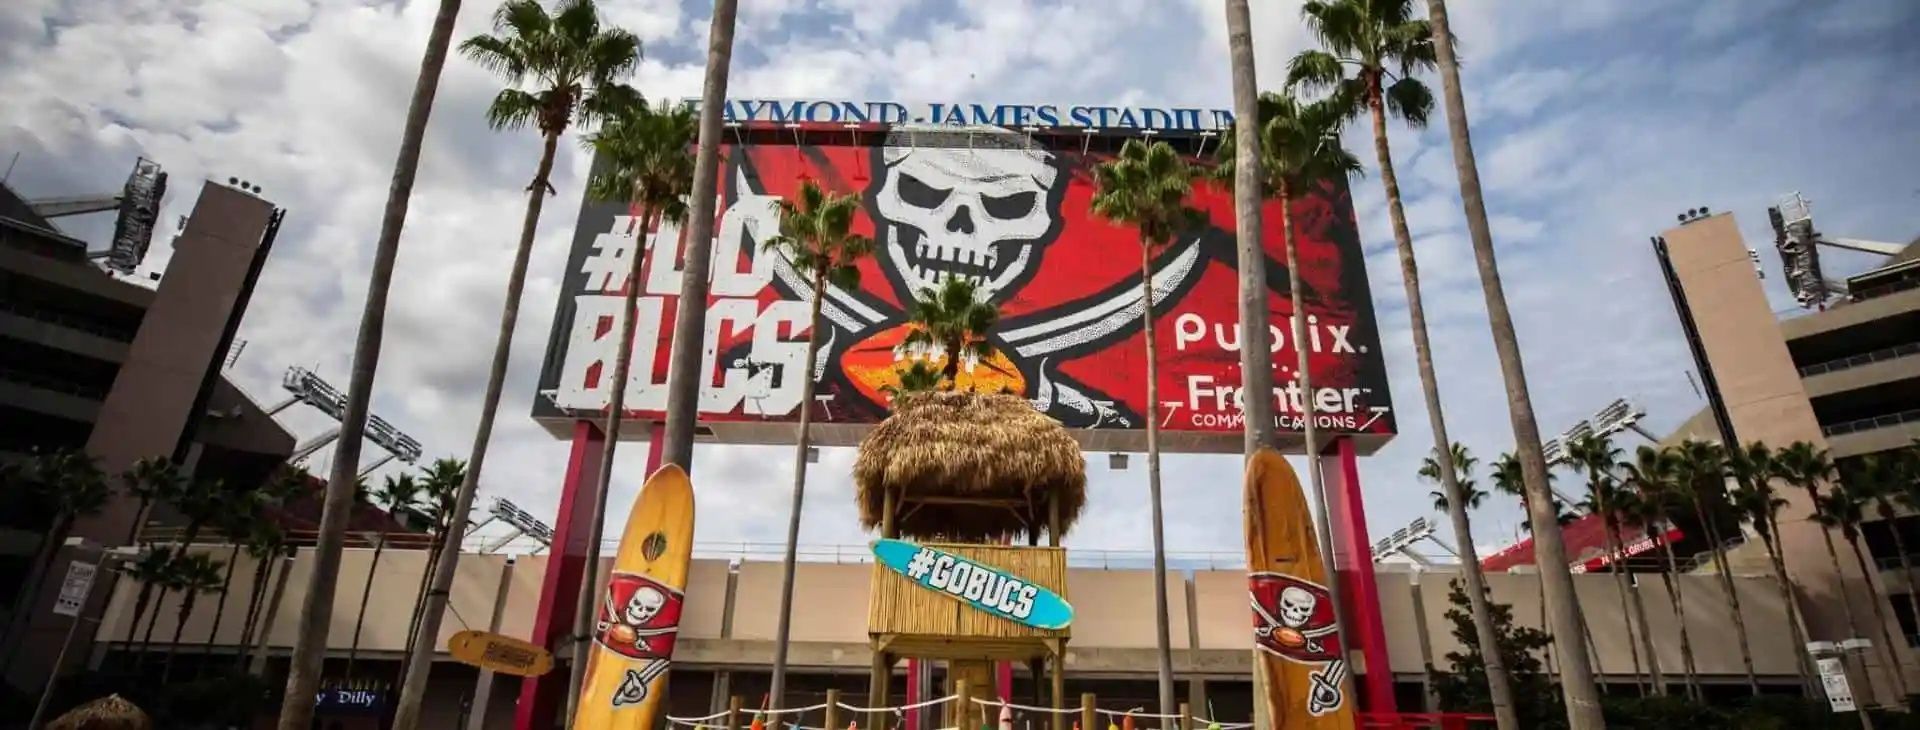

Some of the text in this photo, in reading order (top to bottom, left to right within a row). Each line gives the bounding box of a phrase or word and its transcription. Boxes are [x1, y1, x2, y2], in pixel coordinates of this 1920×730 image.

[928, 103, 1057, 127] JAMES
[555, 295, 816, 415] BUCS
[907, 547, 1038, 619] #GOBUCS
[338, 691, 376, 707] Dilly
